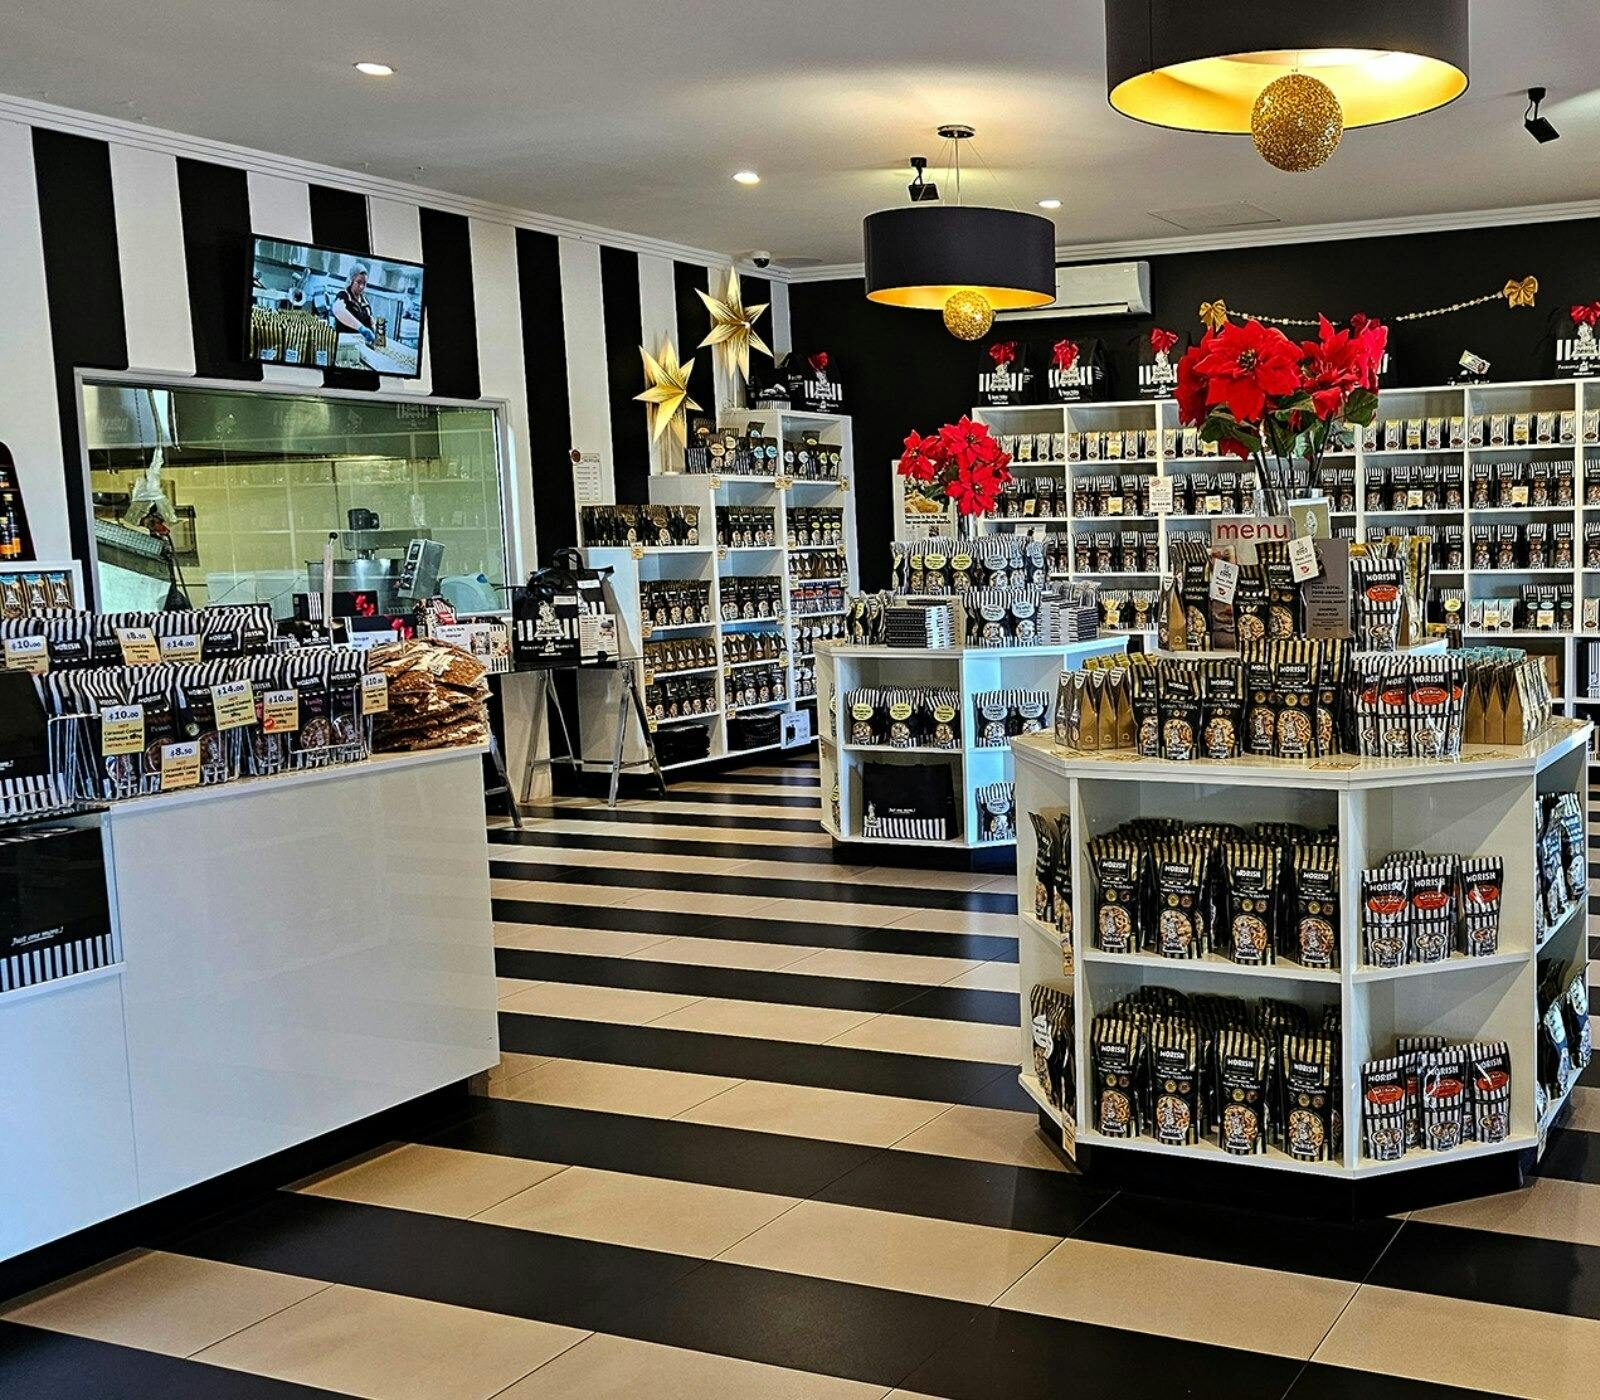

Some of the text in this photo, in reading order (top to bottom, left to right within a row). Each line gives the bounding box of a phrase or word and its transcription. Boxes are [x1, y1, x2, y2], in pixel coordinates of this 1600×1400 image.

[1216, 524, 1288, 539] menu
[1366, 573, 1397, 581] MORISH
[166, 640, 195, 649] $14.00
[1412, 674, 1444, 683] MORISH
[217, 685, 245, 696] $14.00
[268, 694, 294, 704] $10.00
[108, 711, 139, 720] $10.00
[170, 747, 193, 757] $8.50
[1164, 865, 1190, 873] MORISH
[1466, 872, 1497, 882] MORISH
[1414, 878, 1446, 887] MORISH
[1101, 1045, 1126, 1054] MORISH
[1160, 1050, 1185, 1060] MORISH
[1227, 1059, 1254, 1068] MORISH
[1368, 1071, 1398, 1082] MORISH
